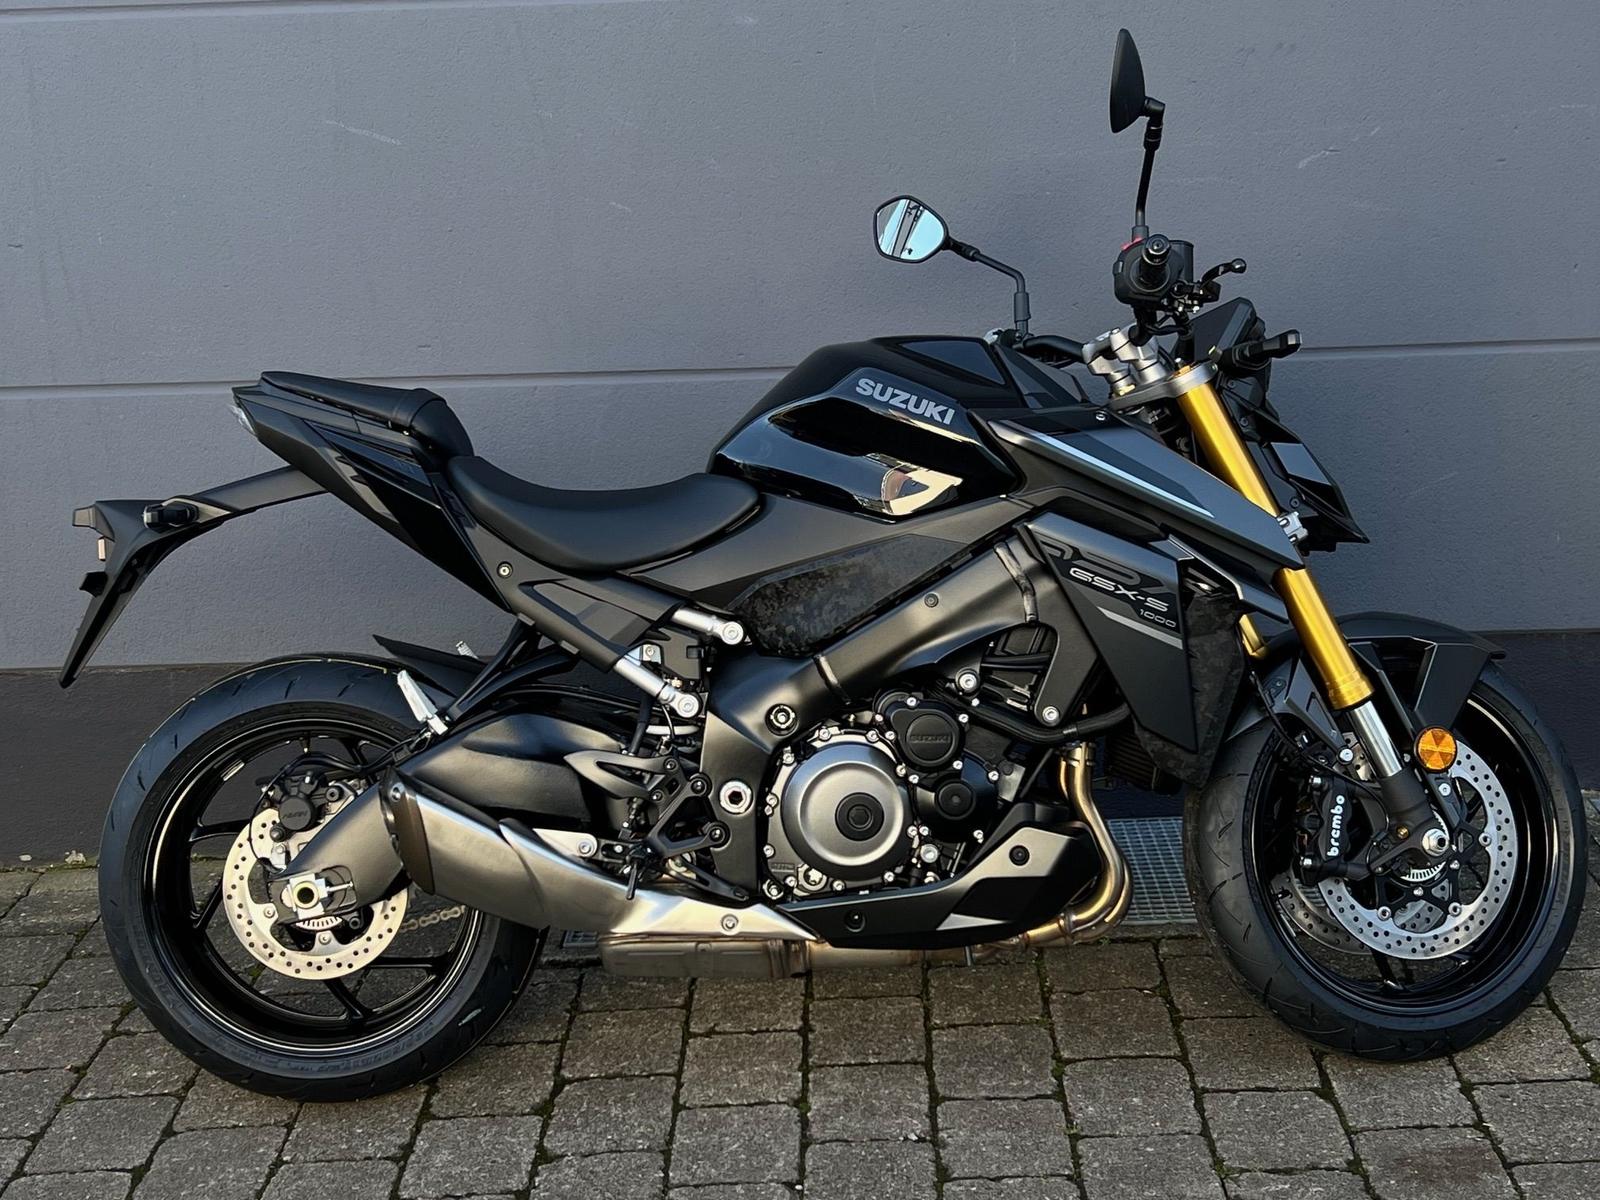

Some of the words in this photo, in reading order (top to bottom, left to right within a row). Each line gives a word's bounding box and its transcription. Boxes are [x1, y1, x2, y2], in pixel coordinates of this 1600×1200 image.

[855, 378, 955, 425] SUZUKI
[1069, 567, 1169, 612] GSX-S
[1140, 609, 1176, 628] 1000
[1327, 795, 1345, 856] brembo
